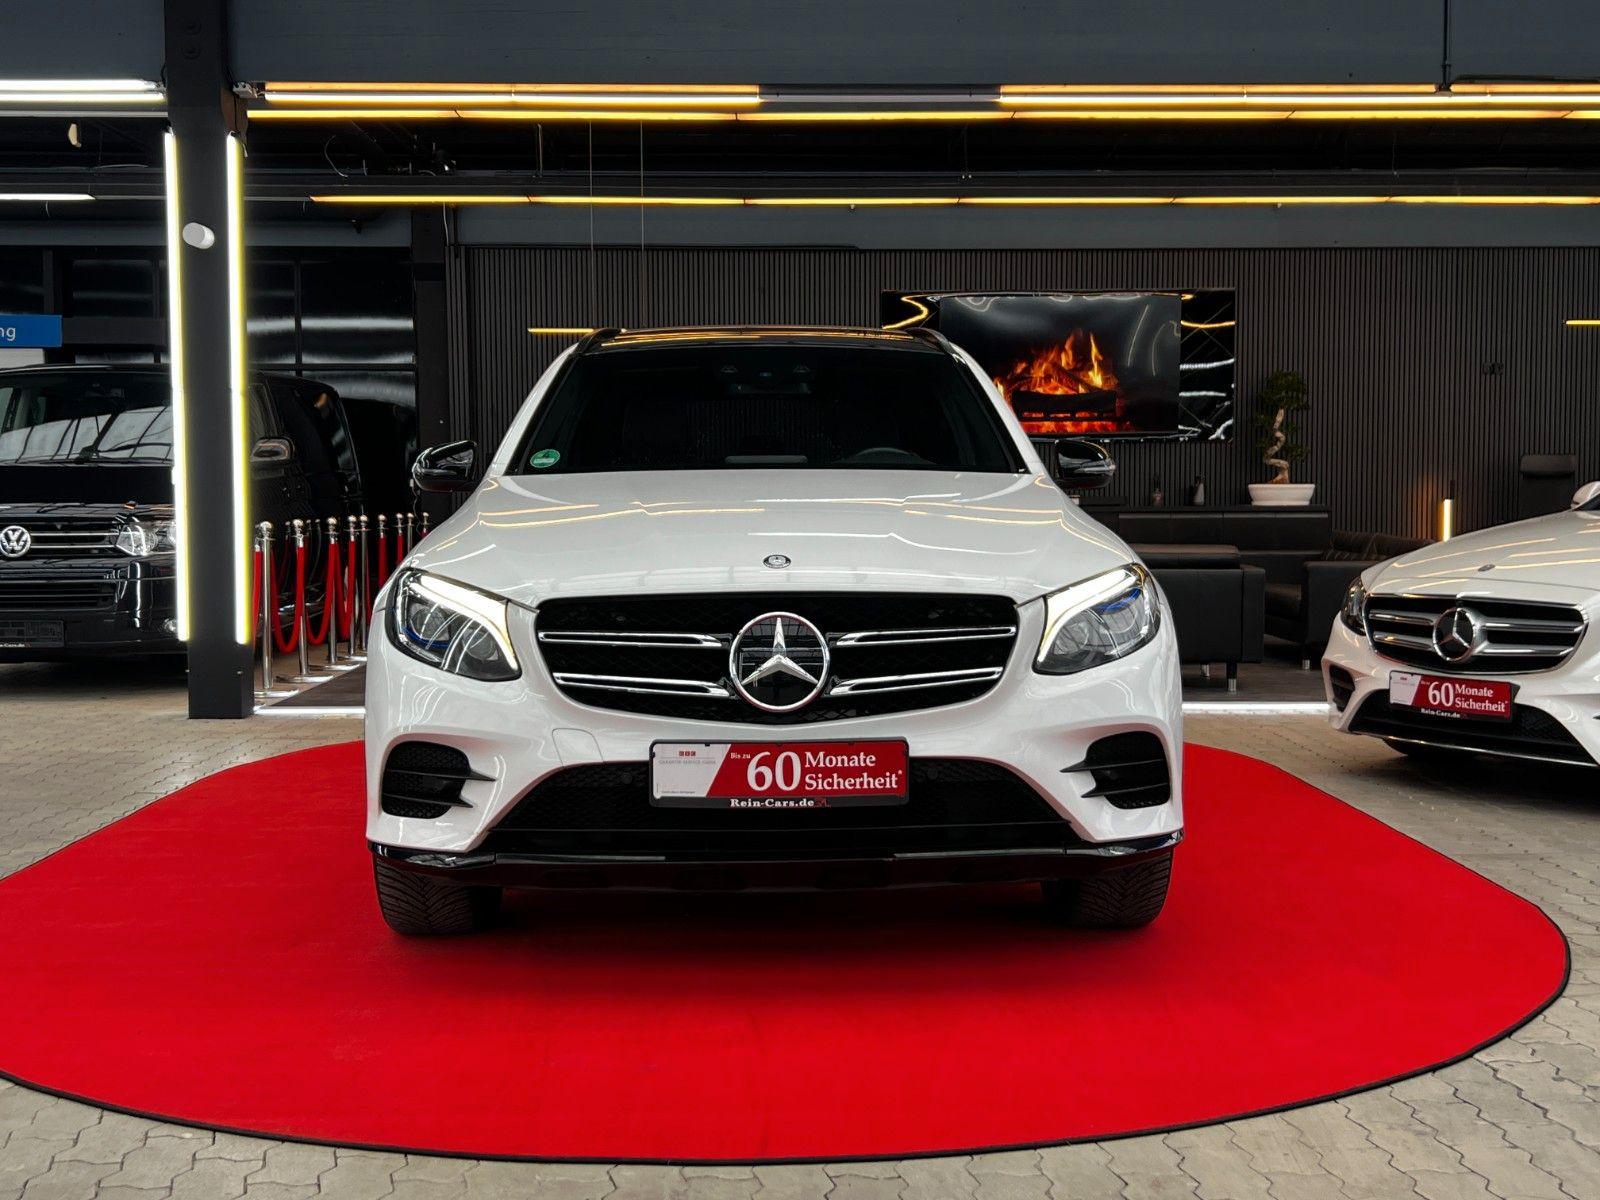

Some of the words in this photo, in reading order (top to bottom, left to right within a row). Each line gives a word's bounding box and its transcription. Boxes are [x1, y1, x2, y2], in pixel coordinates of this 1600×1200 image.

[1428, 681, 1454, 707] 60
[1455, 683, 1494, 698] Monate
[747, 751, 801, 791] 60
[804, 751, 876, 768] Monate
[730, 798, 815, 808] Rein-Cars.de
